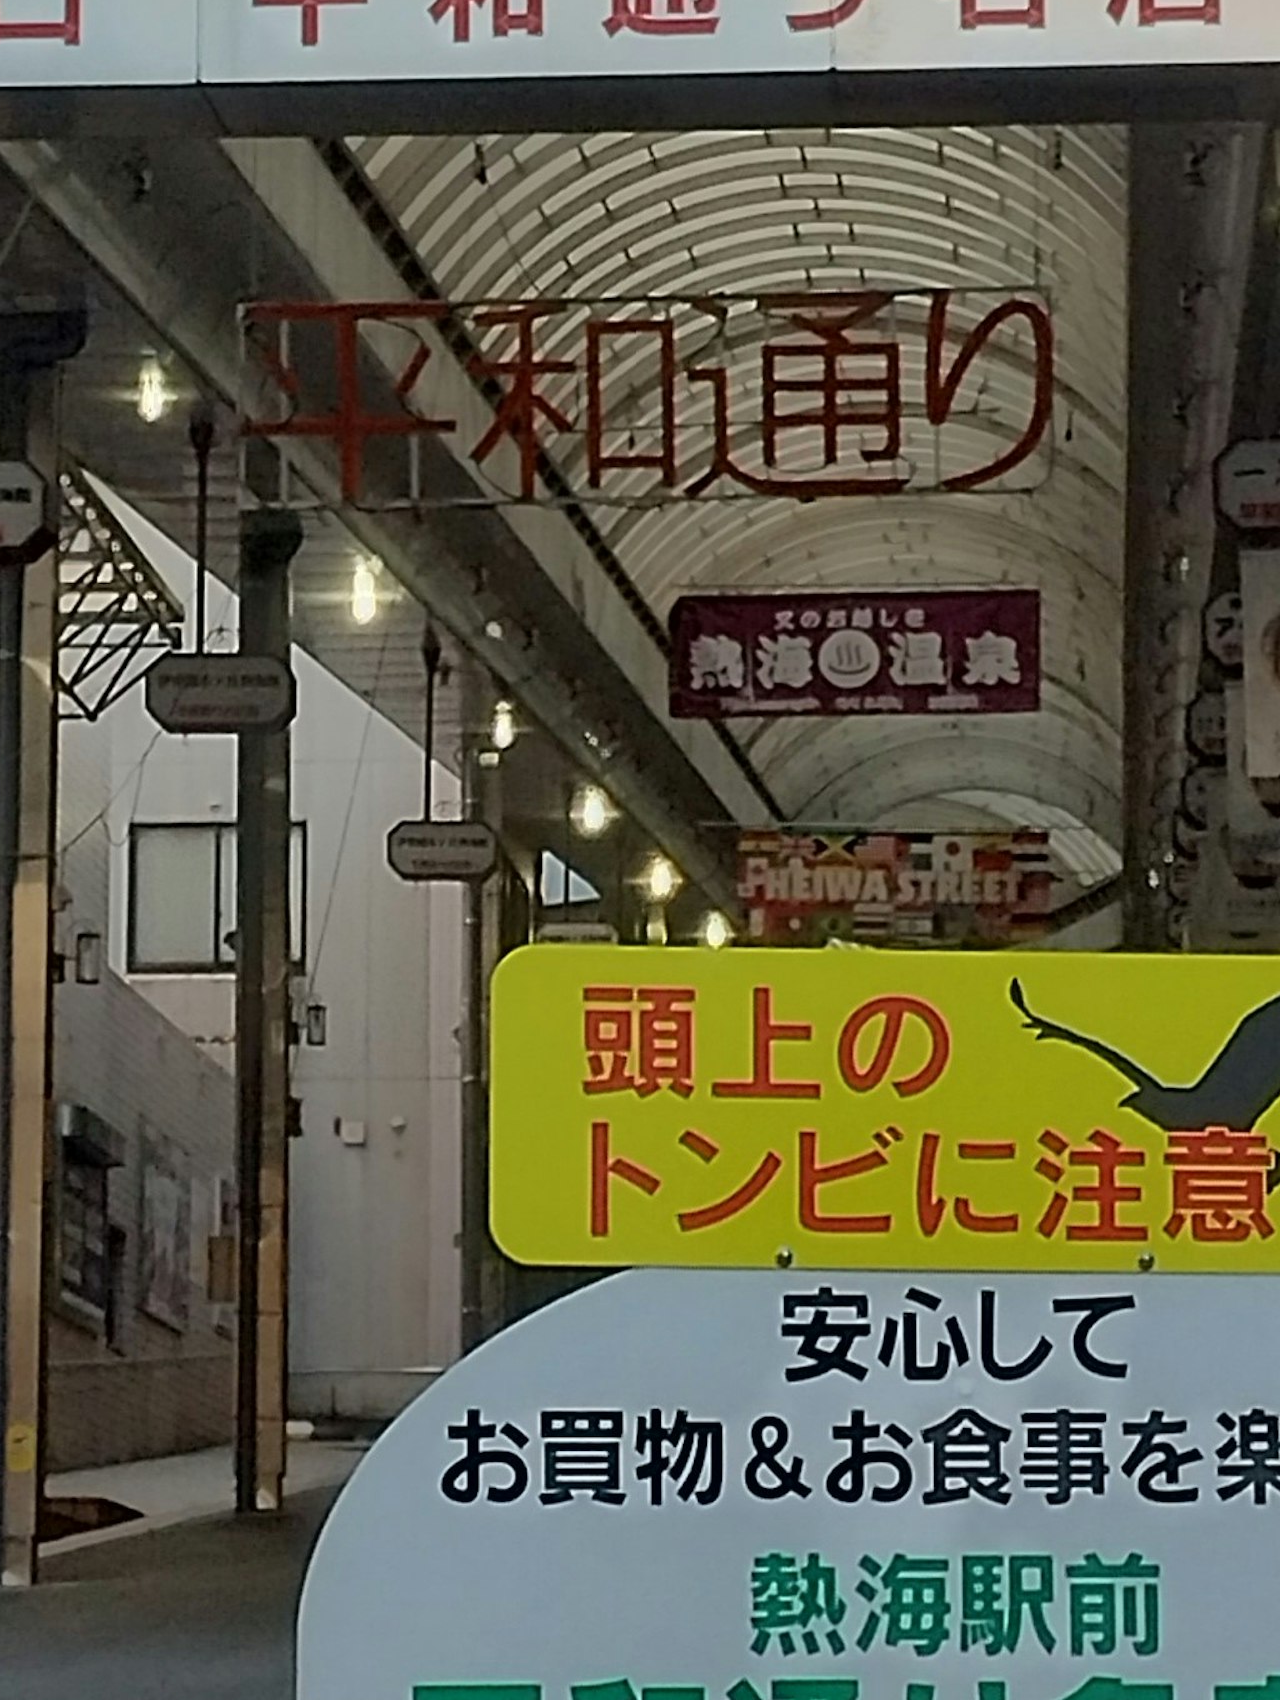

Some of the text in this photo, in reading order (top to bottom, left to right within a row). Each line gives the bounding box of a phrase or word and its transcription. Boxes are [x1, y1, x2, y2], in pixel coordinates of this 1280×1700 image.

[244, 287, 1055, 500] 平和通り
[581, 984, 950, 1100] 頭上の
[780, 1286, 1136, 1384] 安心して
[749, 1552, 1161, 1658] 熱海駅前
